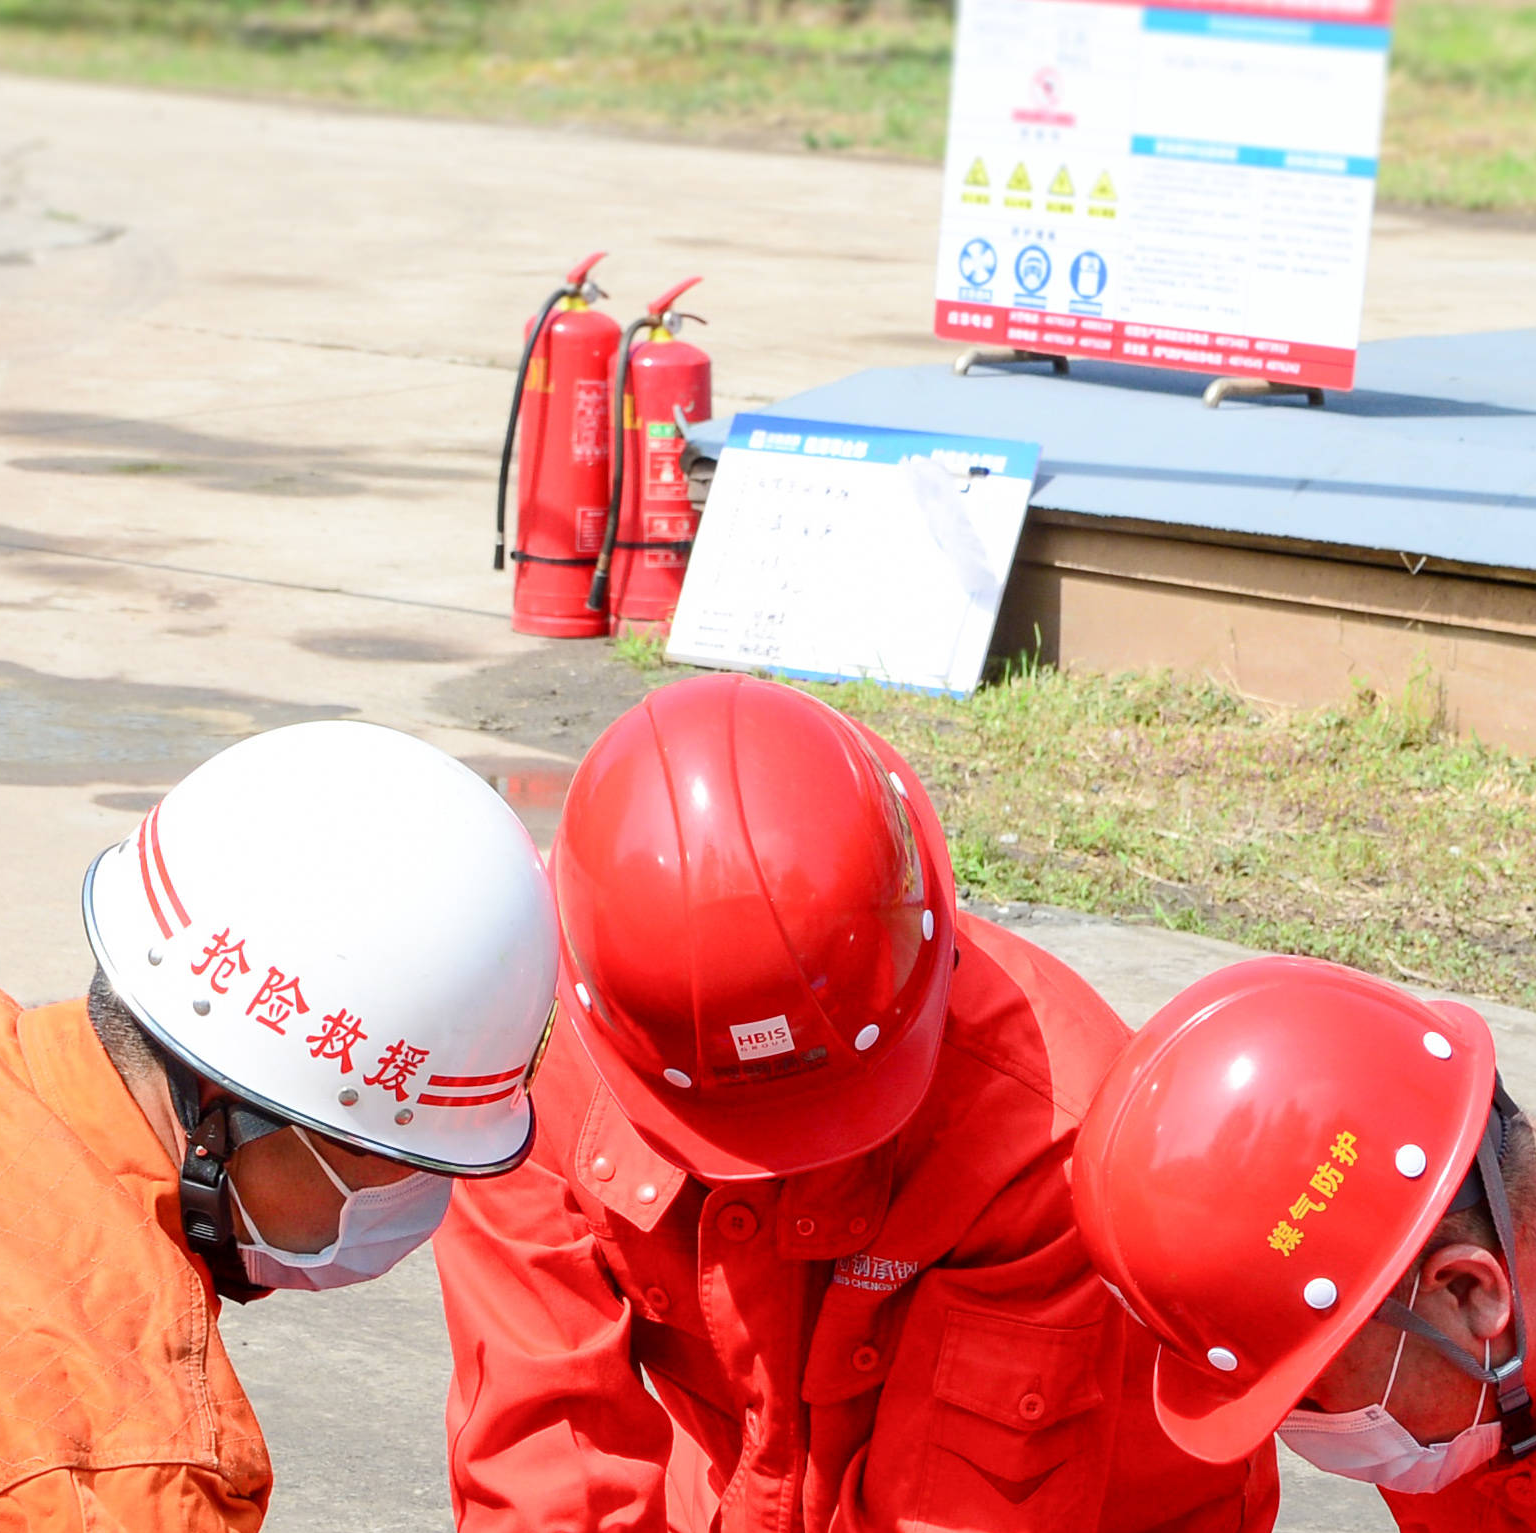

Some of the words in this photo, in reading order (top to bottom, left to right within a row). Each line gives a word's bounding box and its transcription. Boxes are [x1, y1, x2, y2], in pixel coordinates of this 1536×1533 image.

[191, 927, 431, 1104] 抢险救援
[737, 1027, 787, 1047] HBIS
[1266, 1130, 1361, 1258] 煤气防护
